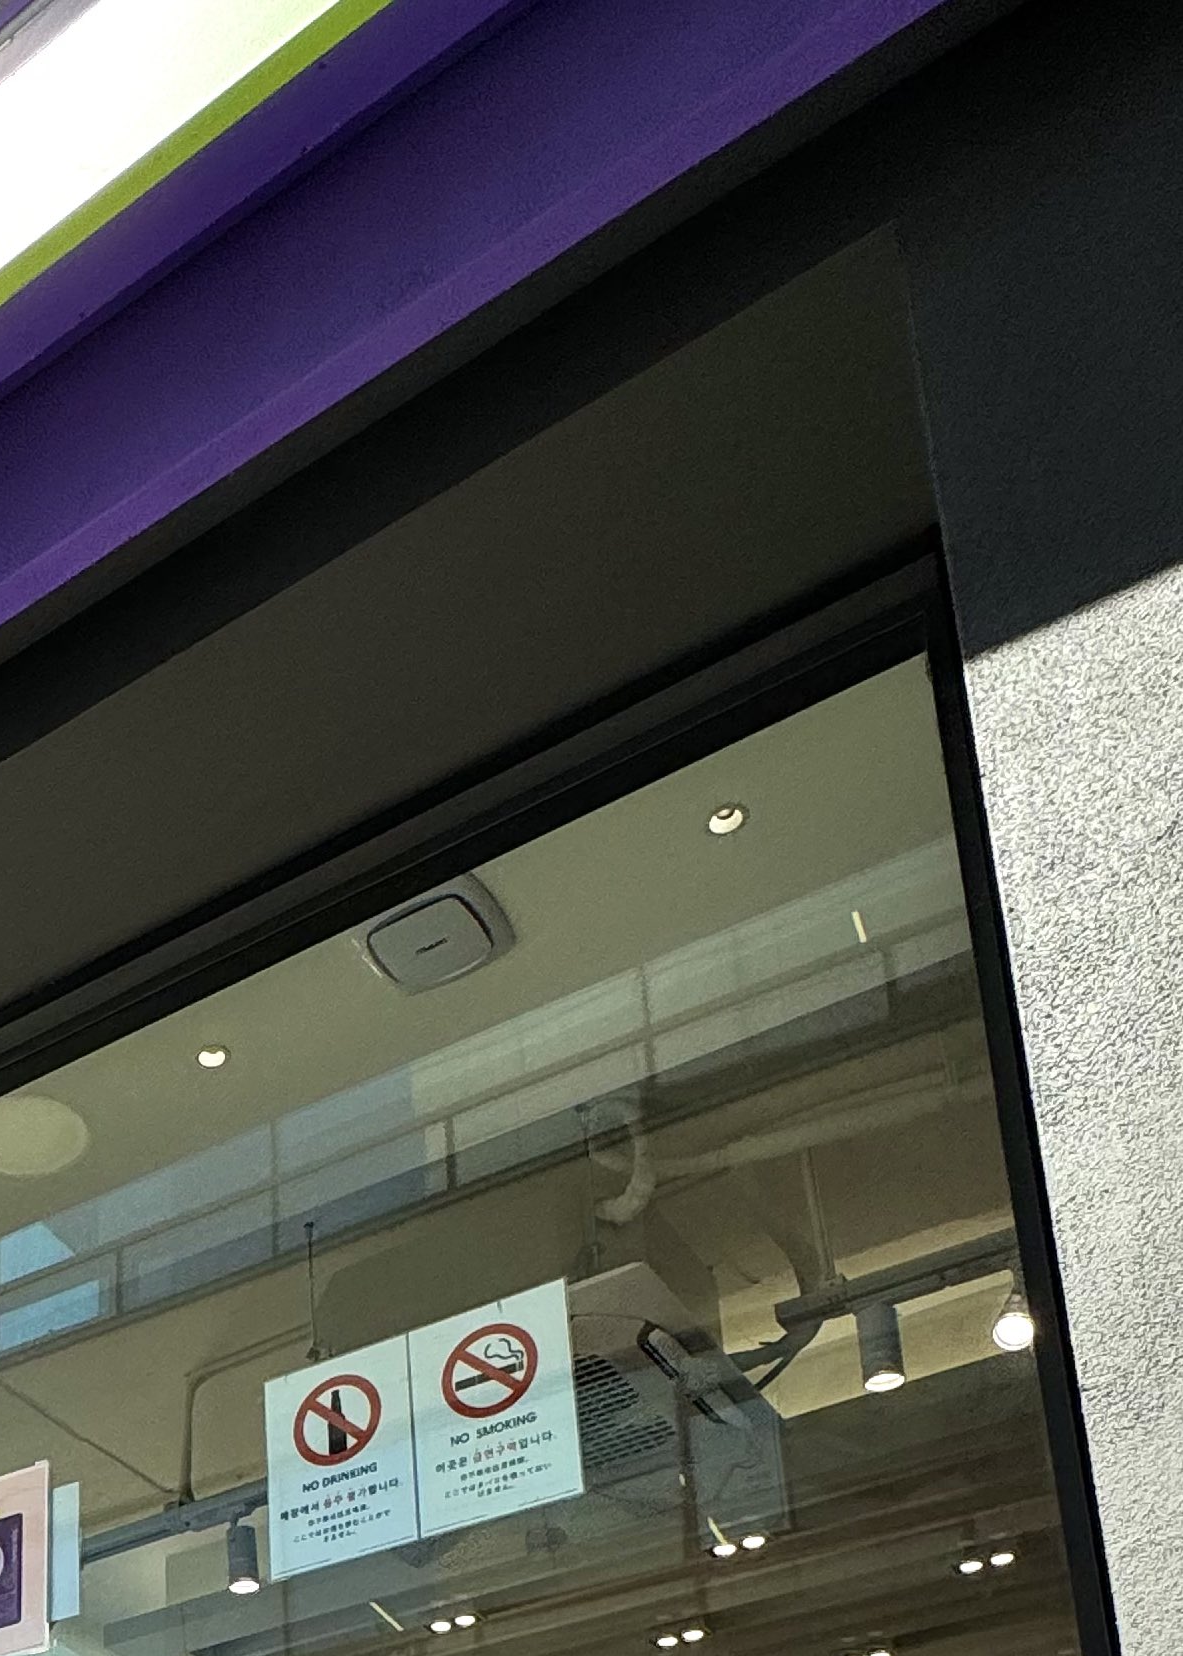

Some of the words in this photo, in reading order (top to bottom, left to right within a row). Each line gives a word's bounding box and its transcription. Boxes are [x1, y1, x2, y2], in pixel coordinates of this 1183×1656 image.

[450, 1433, 470, 1447] NO
[476, 1411, 538, 1439] SMOKING
[302, 1479, 320, 1493] NO
[322, 1462, 378, 1489] DRINKING
